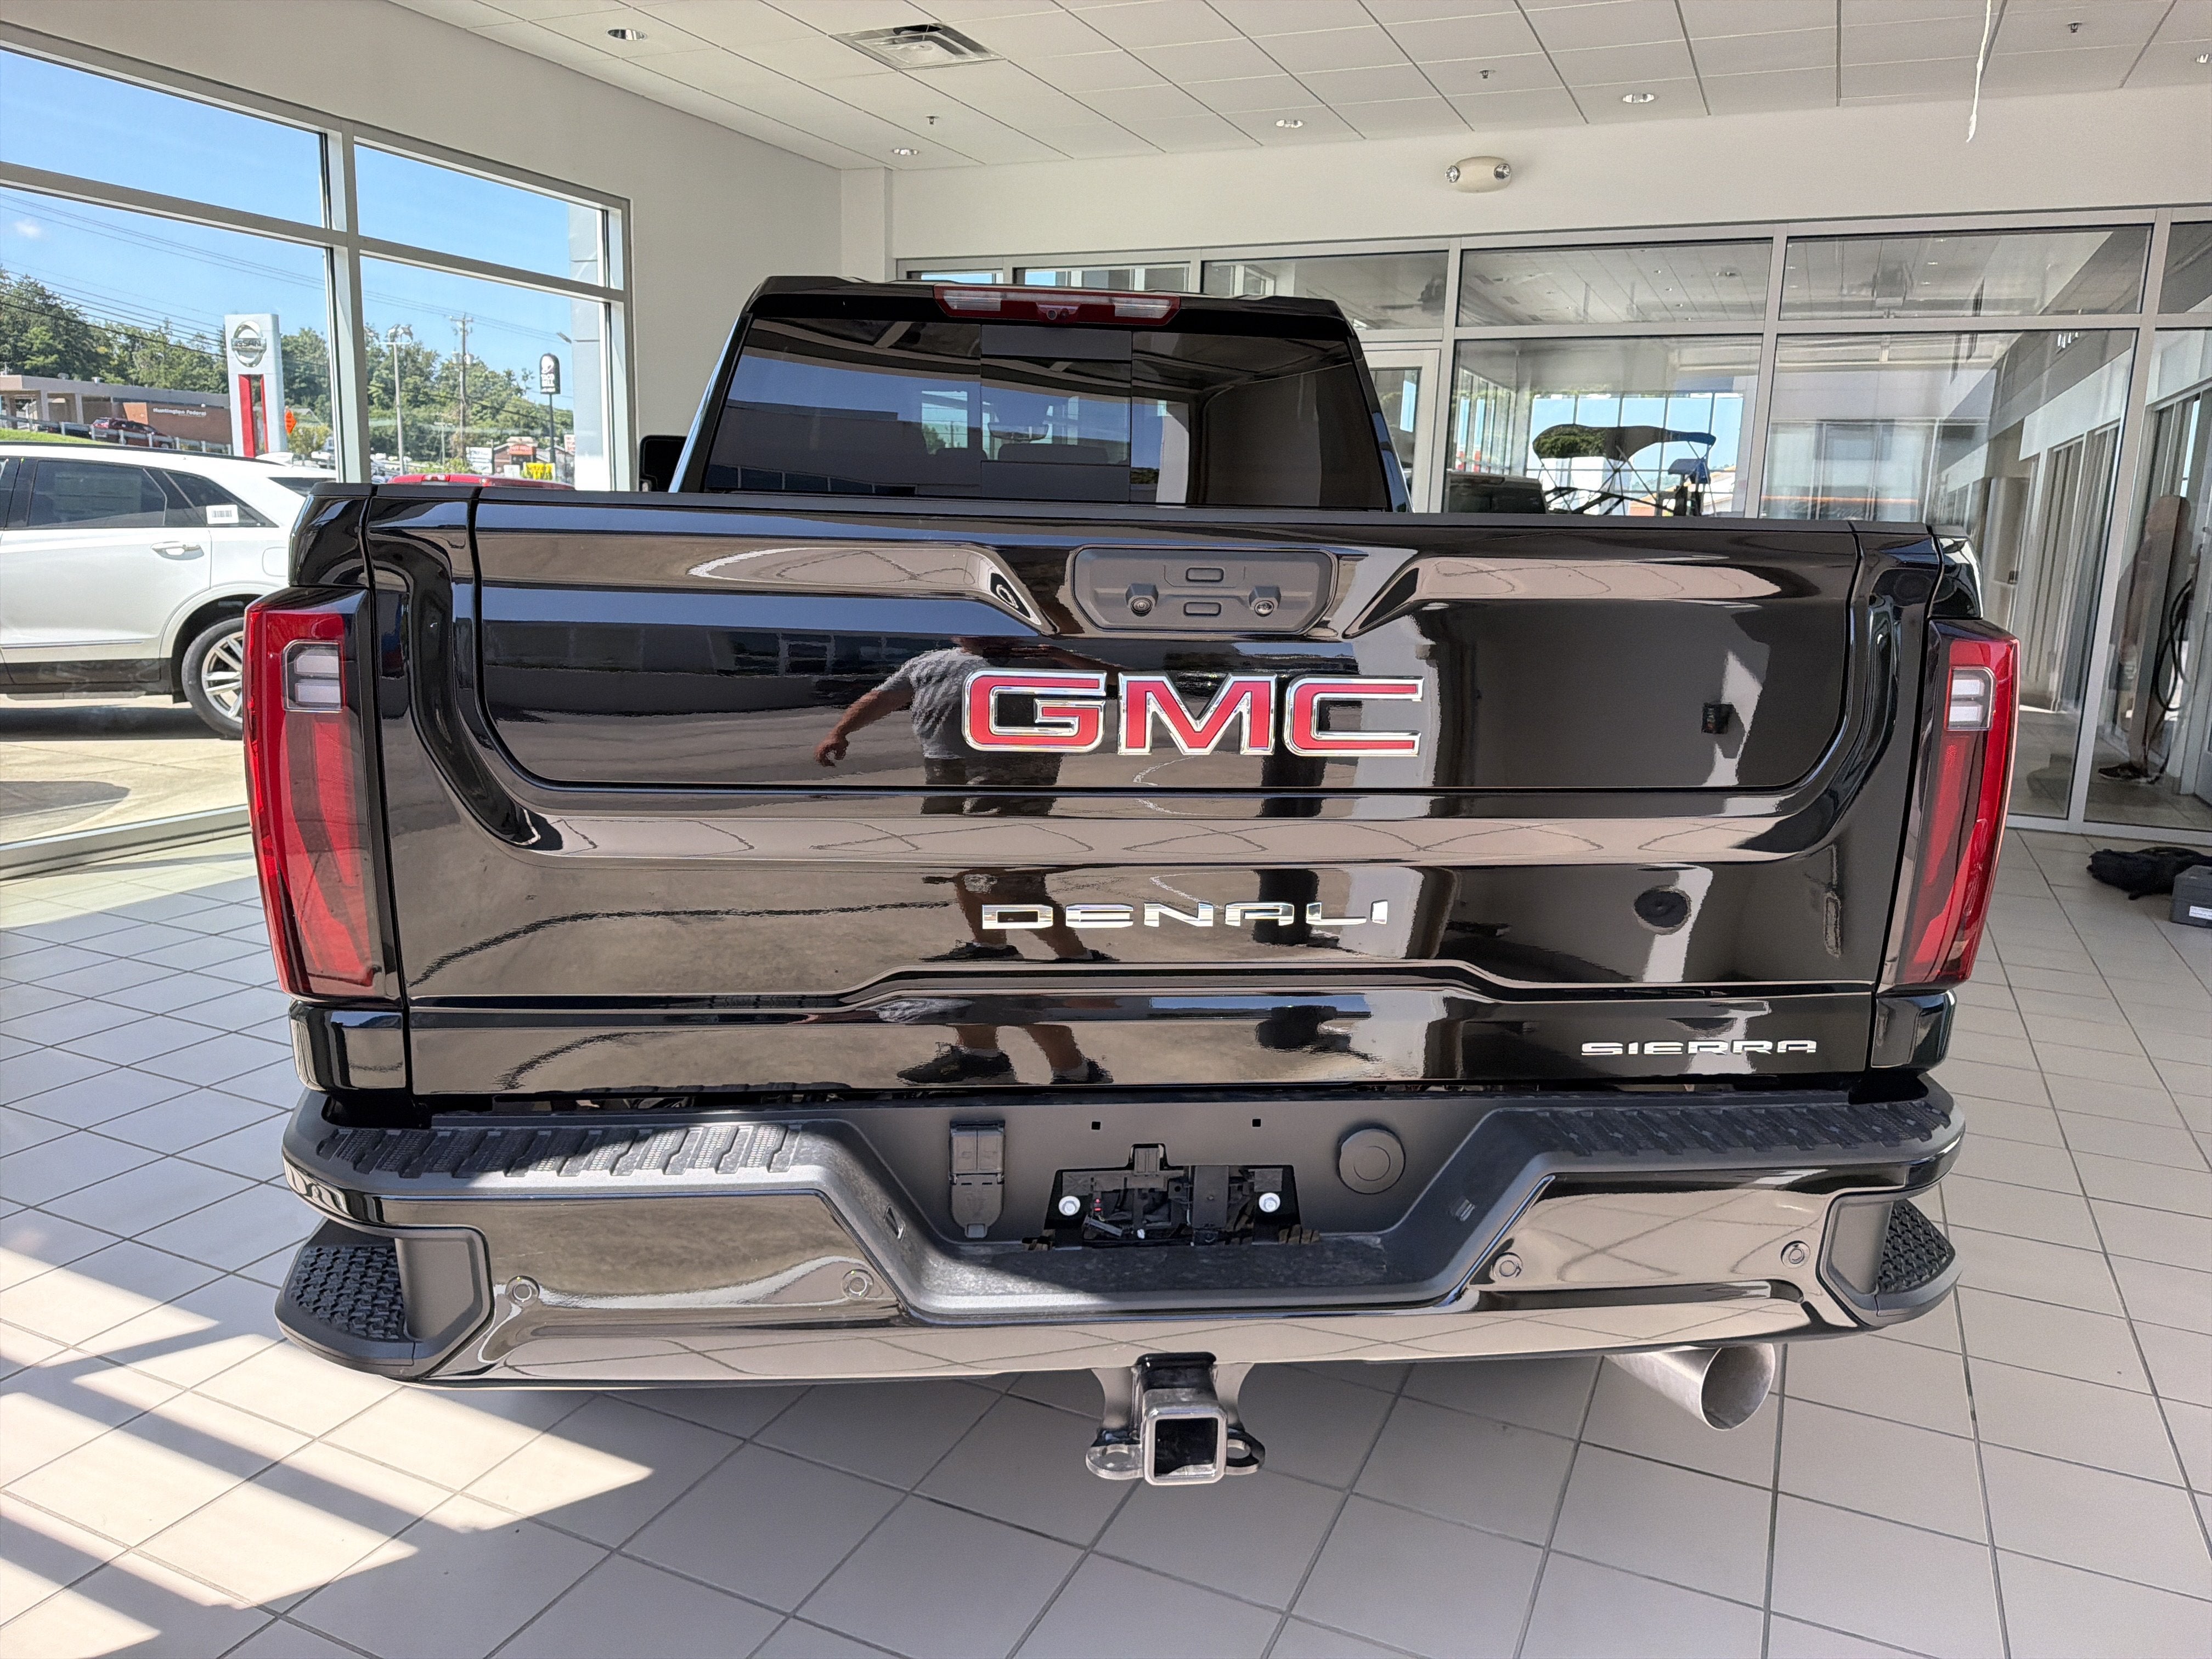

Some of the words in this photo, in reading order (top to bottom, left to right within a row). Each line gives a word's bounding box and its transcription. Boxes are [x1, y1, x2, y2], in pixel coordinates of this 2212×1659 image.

[962, 669, 1425, 757] GMC
[981, 899, 1389, 929] DENALI
[1581, 1040, 1817, 1055] SIERRA
